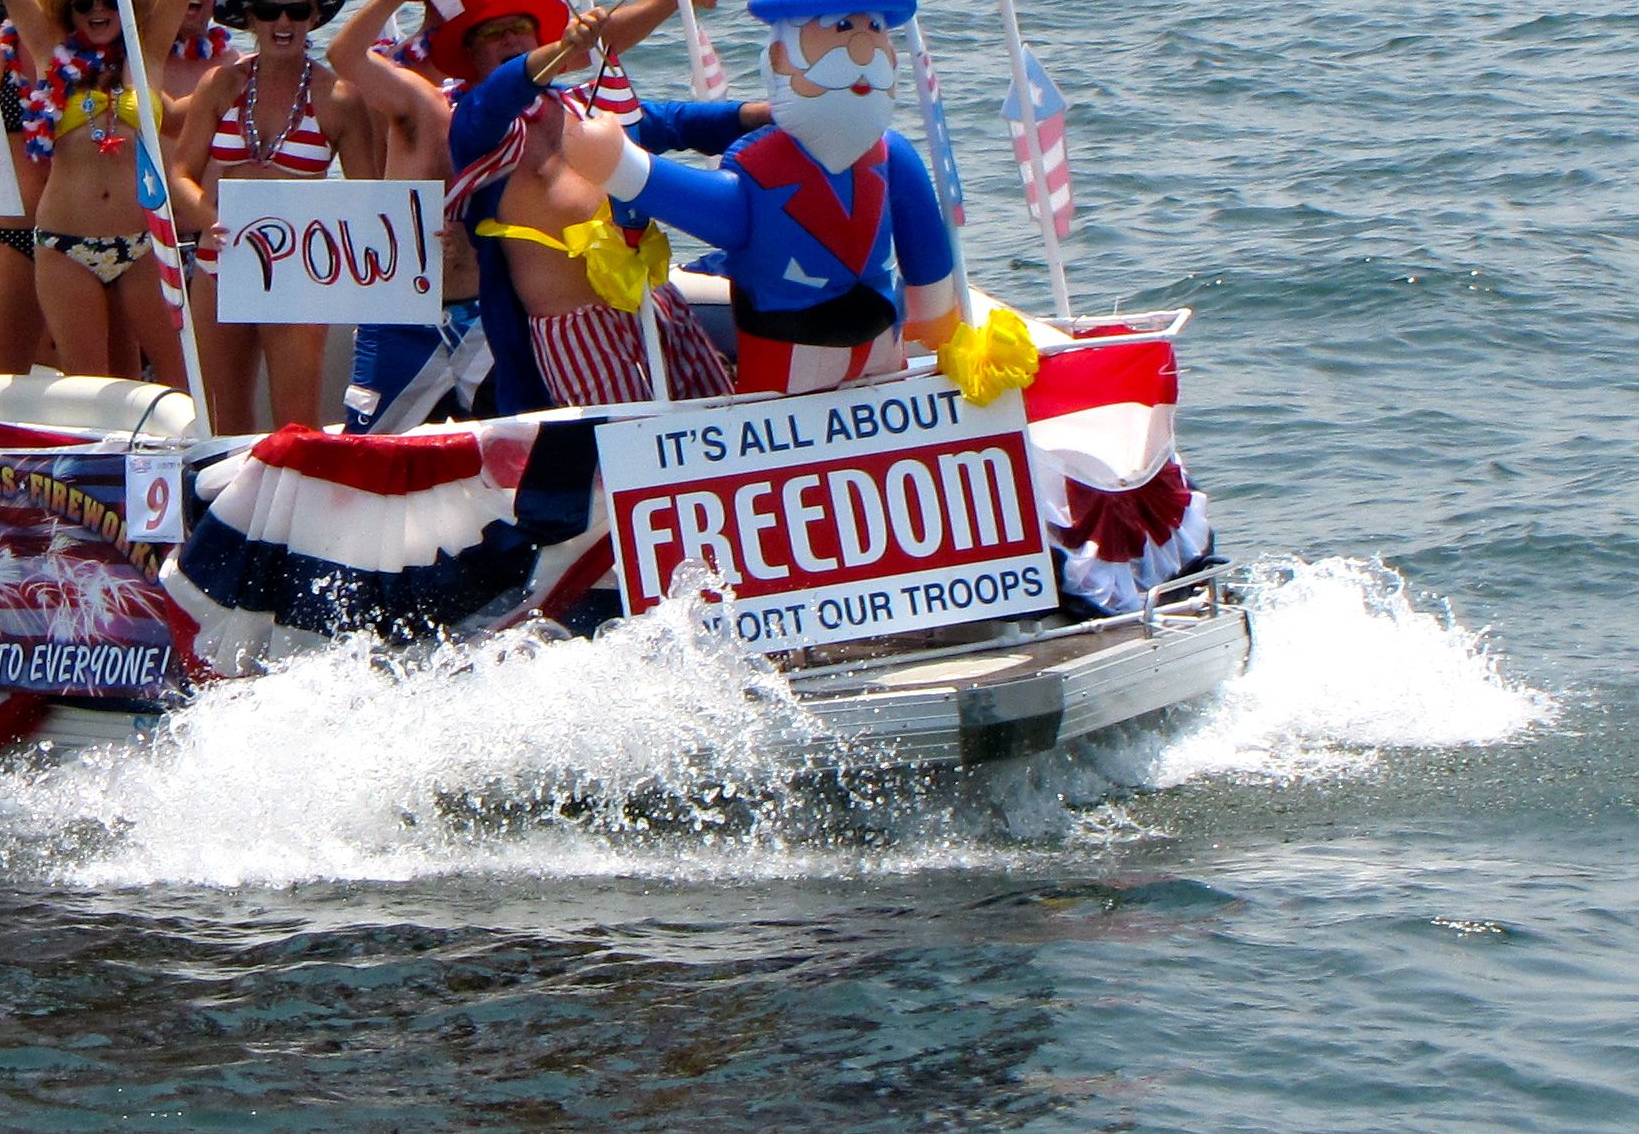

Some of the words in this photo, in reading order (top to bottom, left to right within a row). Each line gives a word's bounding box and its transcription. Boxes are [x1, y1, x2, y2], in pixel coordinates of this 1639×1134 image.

[233, 189, 430, 294] POW!
[656, 425, 728, 468] IT'S
[739, 414, 814, 456] ALL
[825, 390, 963, 443] ABOUT
[145, 477, 170, 531] 9
[630, 446, 1026, 599] FREEDOM
[817, 593, 894, 630] OUR
[900, 566, 1045, 616] TROOPS
[29, 644, 171, 686] EVERYONE!
